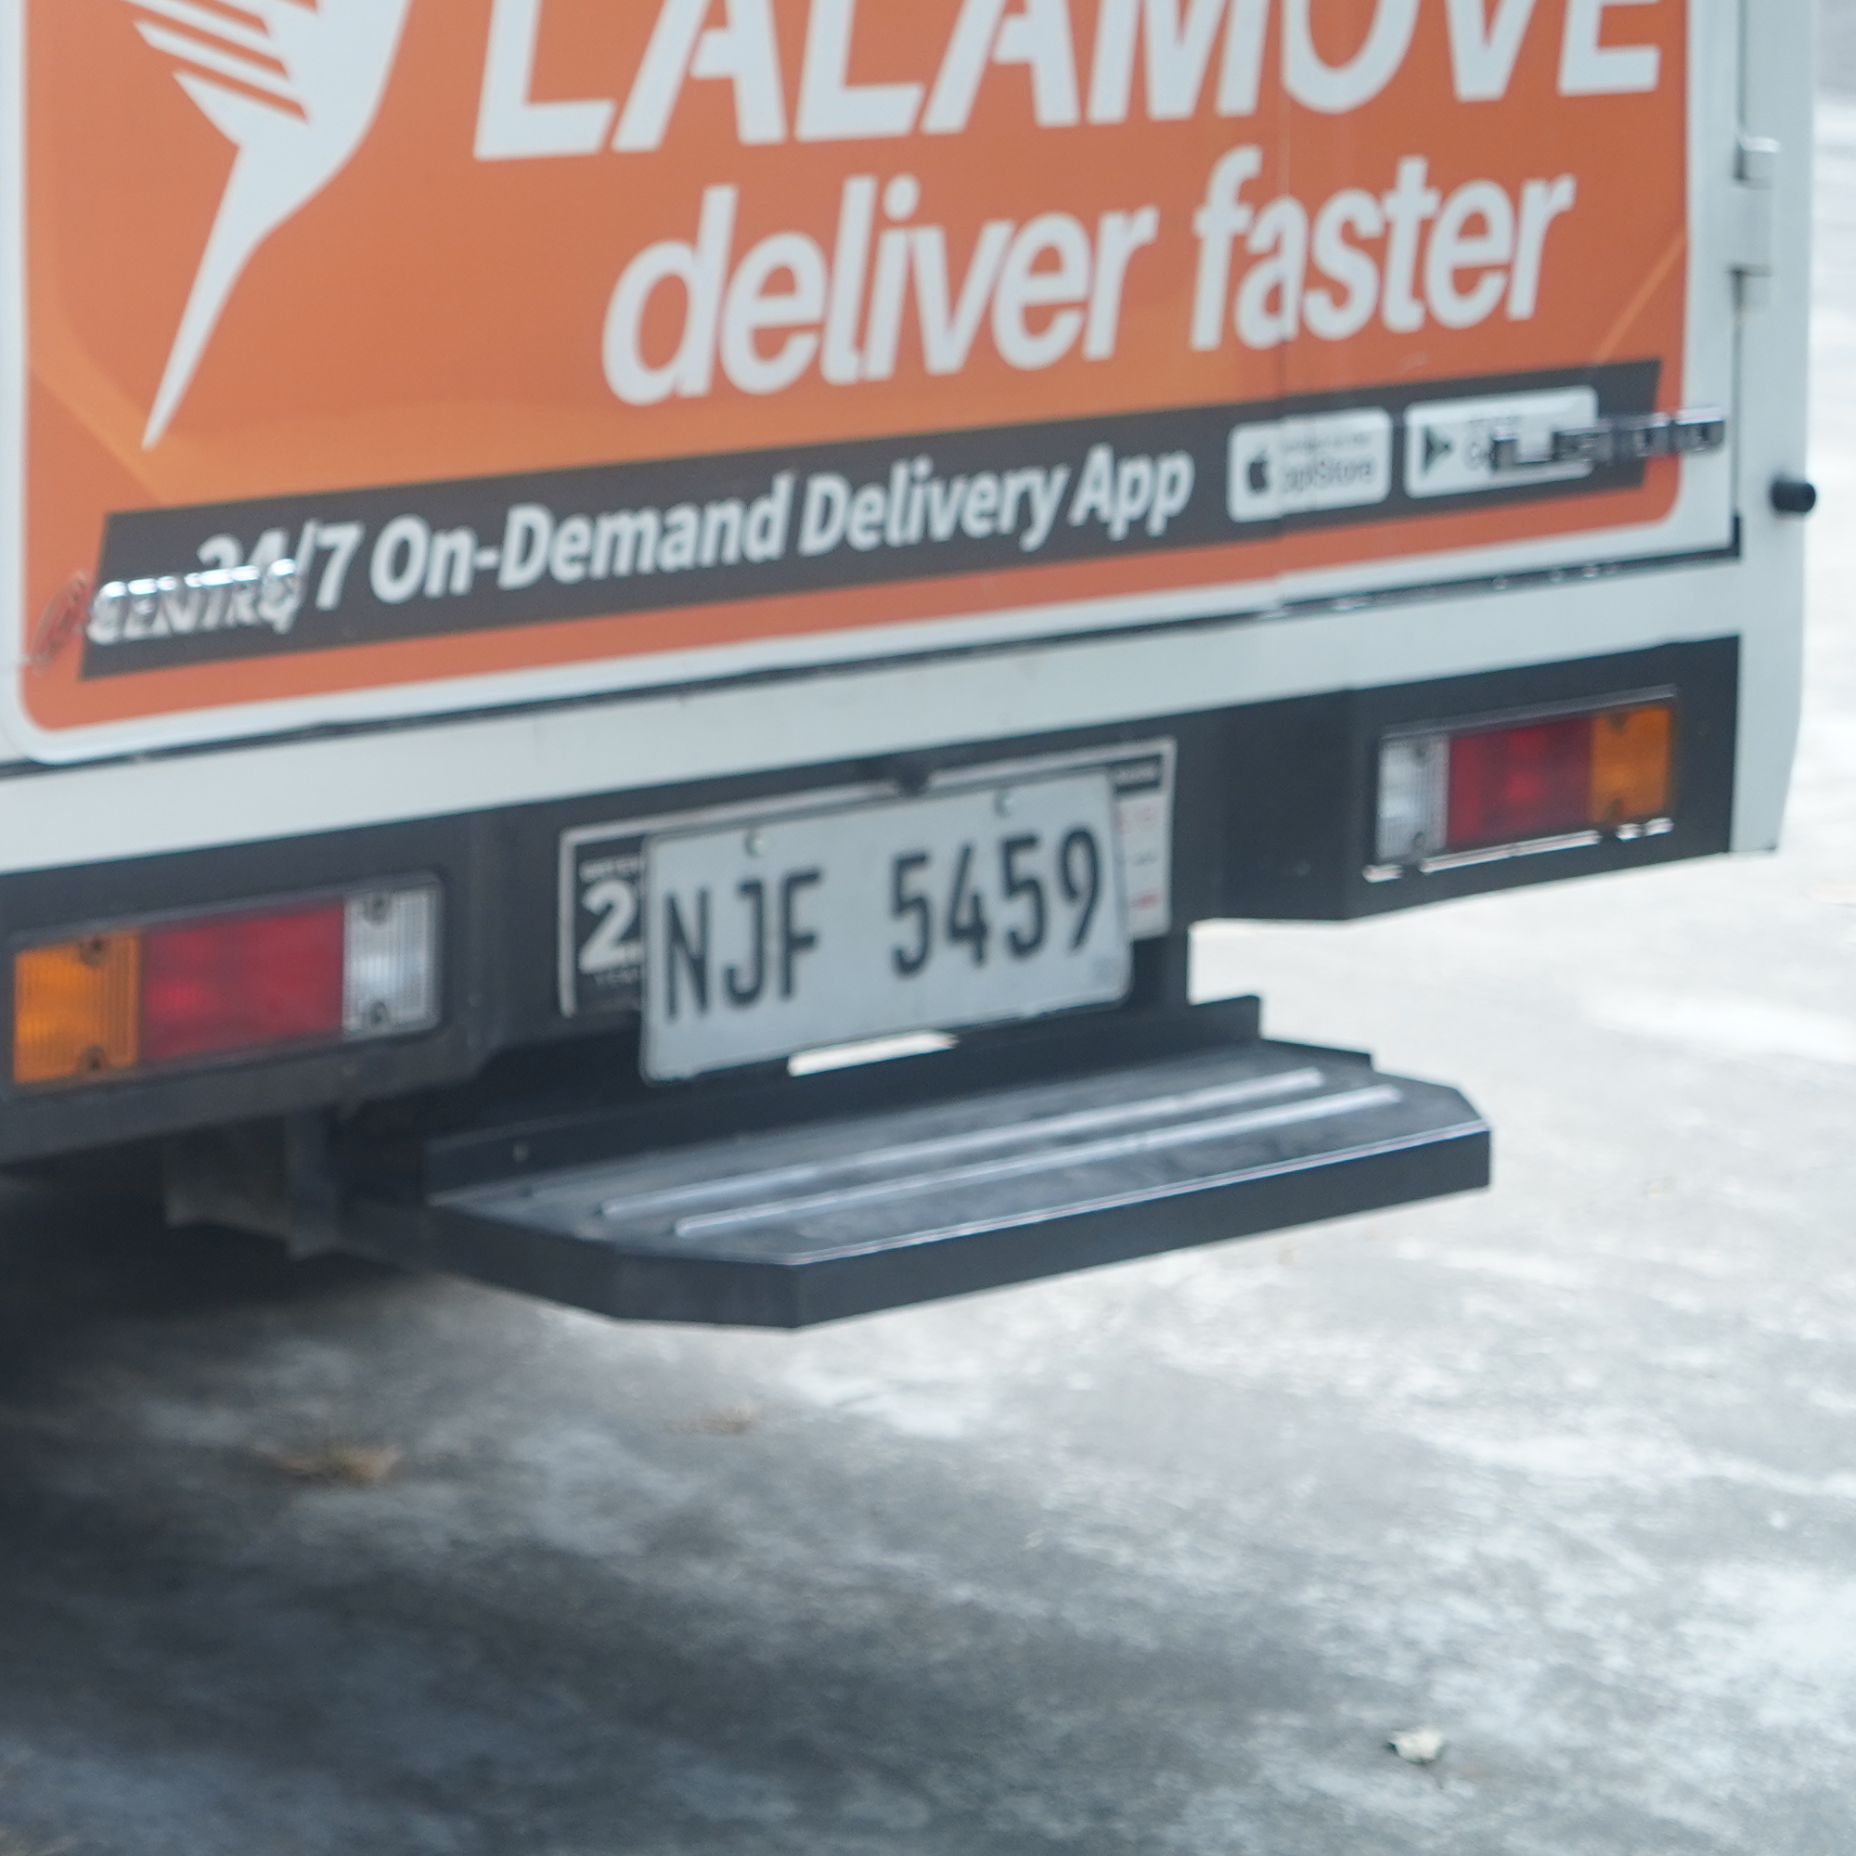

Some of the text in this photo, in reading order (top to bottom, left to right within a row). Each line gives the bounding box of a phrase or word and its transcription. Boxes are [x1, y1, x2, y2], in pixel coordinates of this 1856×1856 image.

[599, 144, 1578, 407] deliver faster
[369, 469, 797, 605] On-Demand
[797, 453, 1072, 557] Delivery
[1067, 442, 1196, 541] App
[664, 826, 1102, 1023] NJF 5459
